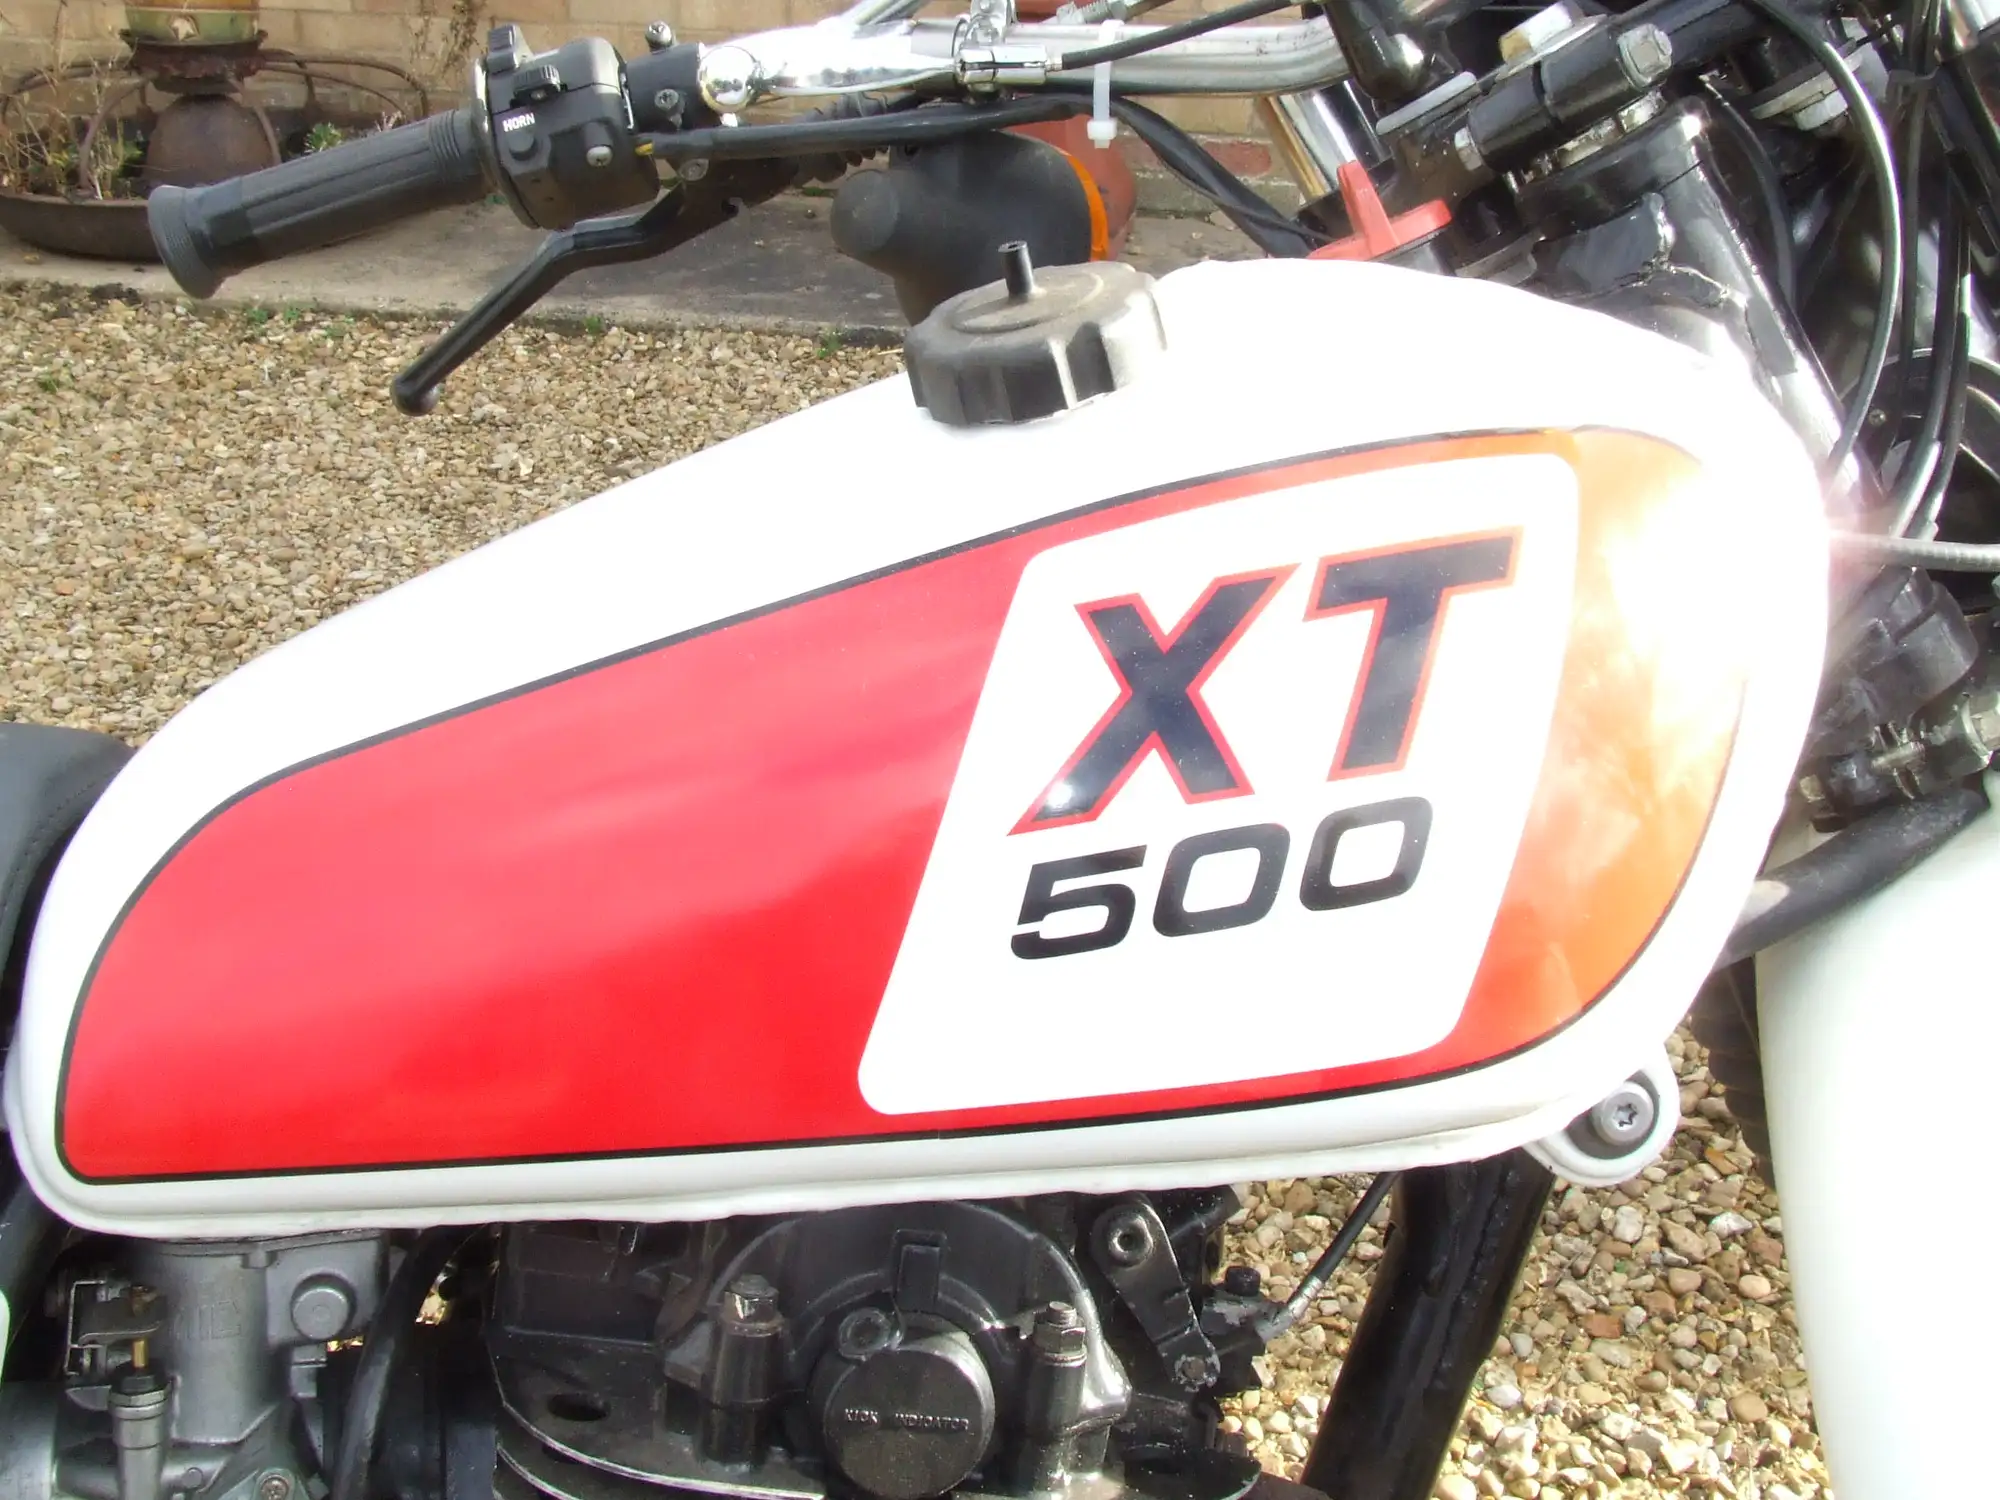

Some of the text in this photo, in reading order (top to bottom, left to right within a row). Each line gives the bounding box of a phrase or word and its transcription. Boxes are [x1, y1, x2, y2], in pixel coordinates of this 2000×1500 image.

[502, 112, 536, 132] HORN
[1006, 525, 1524, 837] XT
[1010, 796, 1433, 960] 500
